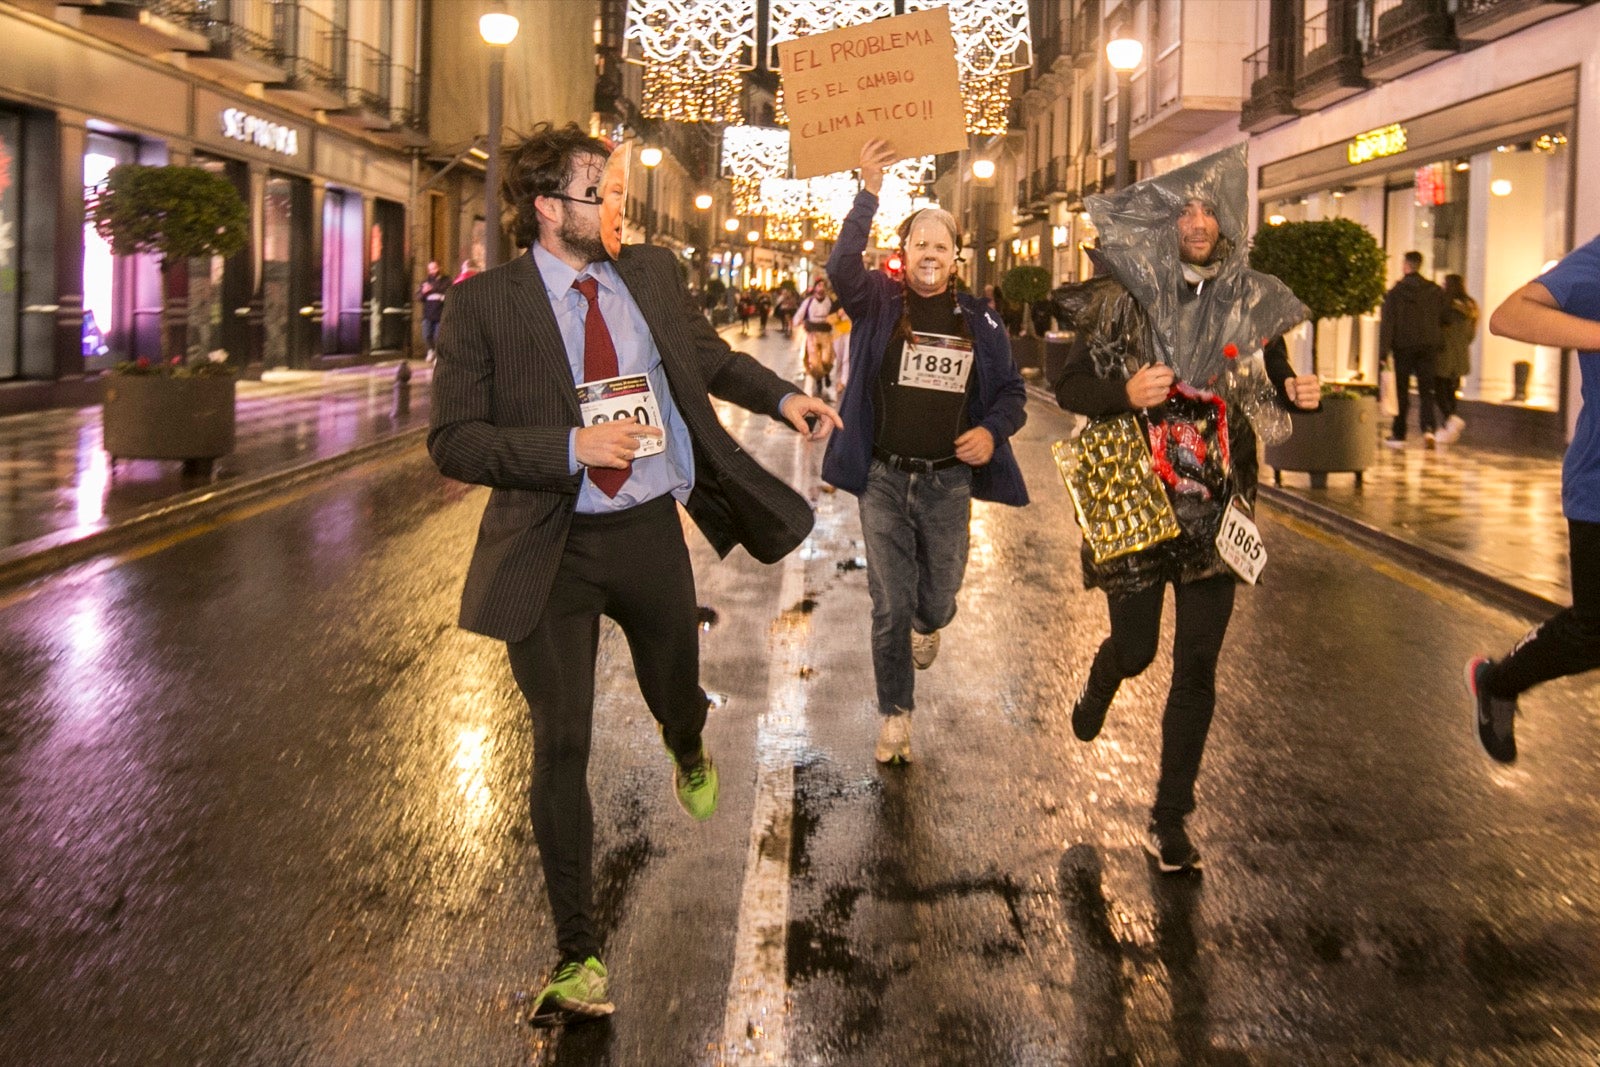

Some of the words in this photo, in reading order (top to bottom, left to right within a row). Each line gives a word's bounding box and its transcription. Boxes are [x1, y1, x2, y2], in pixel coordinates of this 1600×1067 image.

[830, 29, 934, 63] PROBLEMA
[857, 69, 915, 92] CAMBIO
[912, 353, 963, 377] 1881
[1228, 520, 1263, 561] 1865
